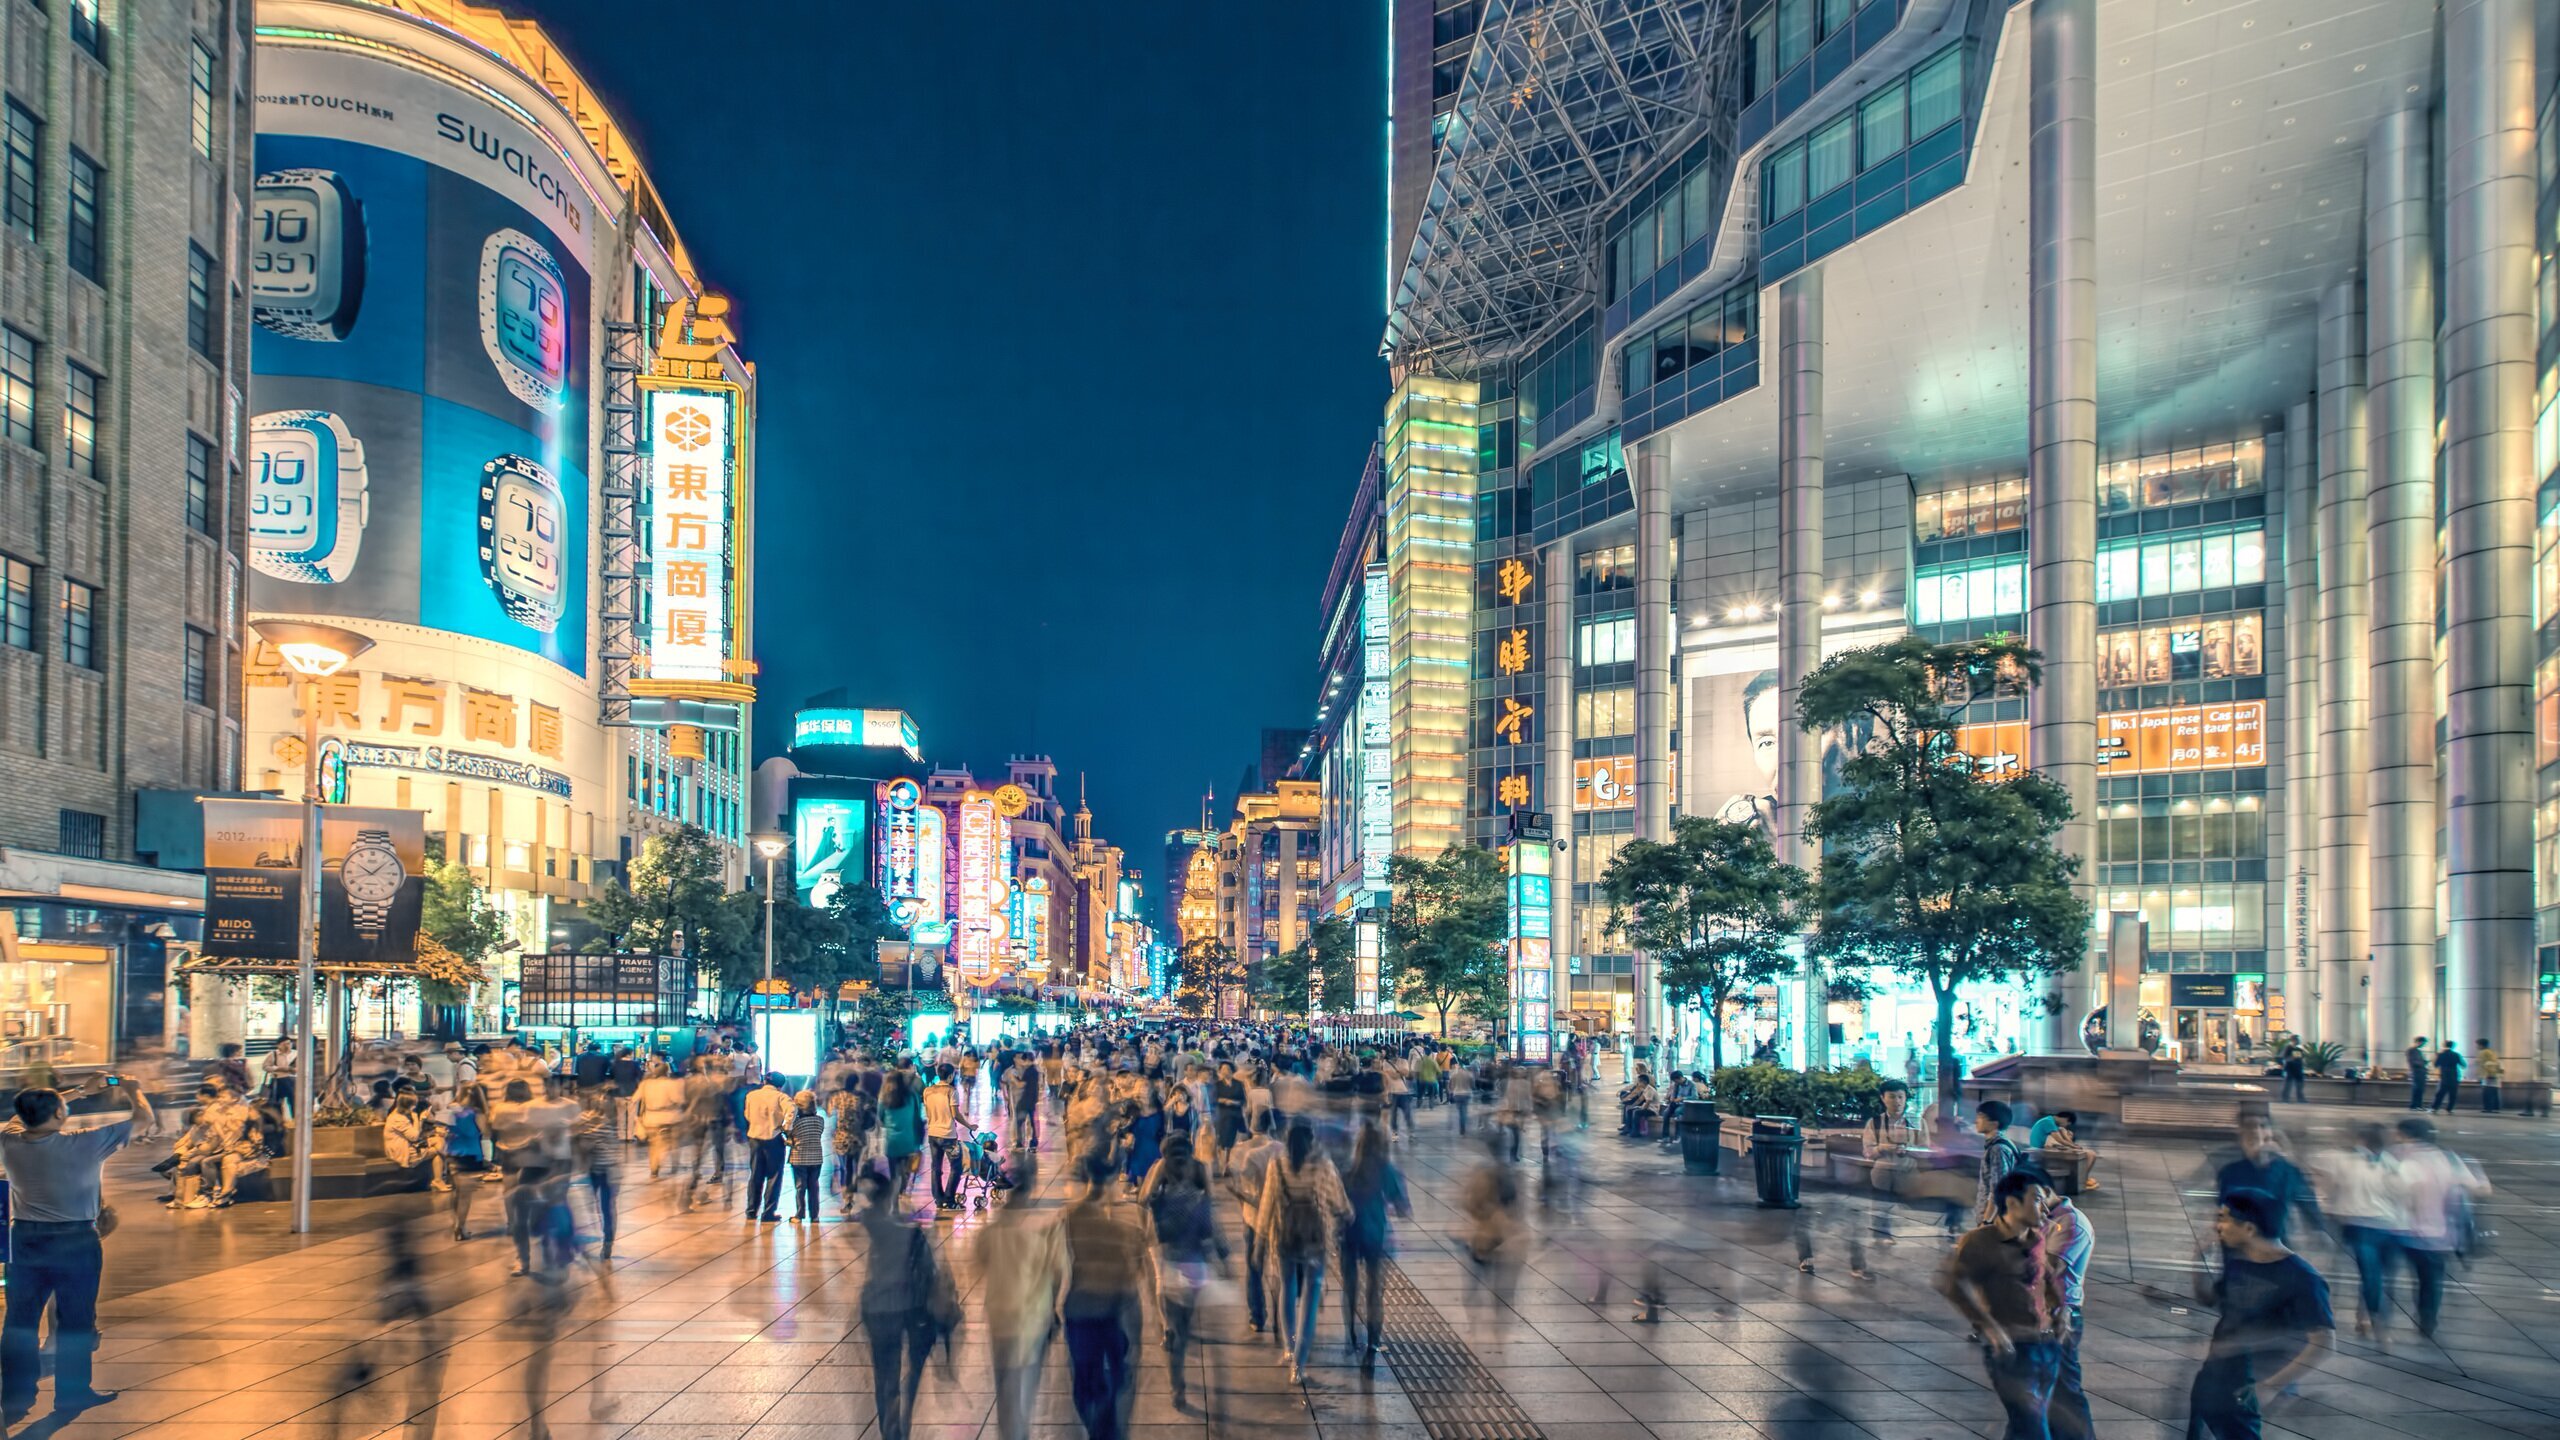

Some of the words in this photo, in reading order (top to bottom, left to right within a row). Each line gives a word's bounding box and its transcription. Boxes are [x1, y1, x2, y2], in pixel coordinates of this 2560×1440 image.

[217, 832, 245, 842] 2012
[218, 919, 252, 930] MIDO
[523, 958, 545, 966] Ticket
[619, 958, 653, 966] TRAVEL
[619, 966, 653, 974] AGENCY
